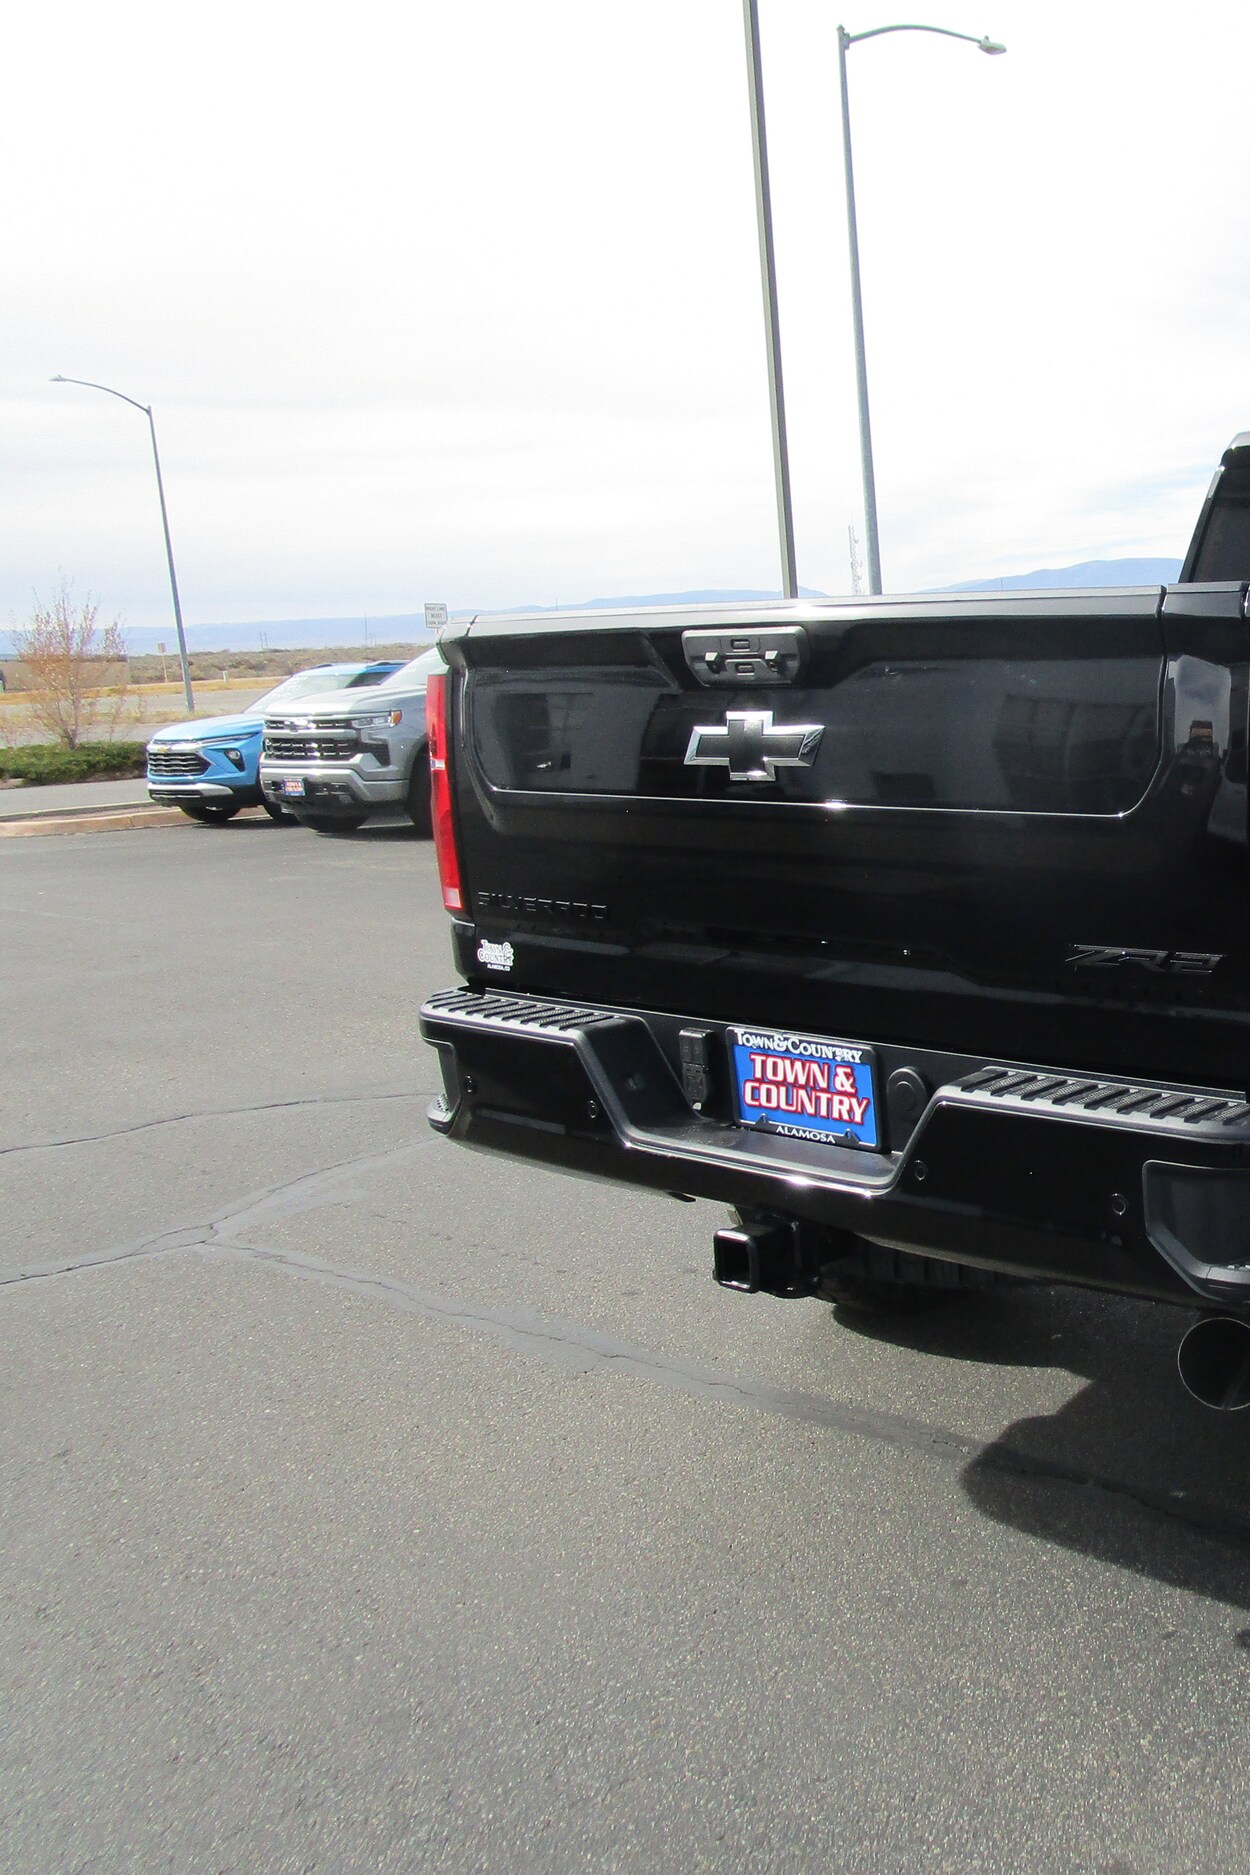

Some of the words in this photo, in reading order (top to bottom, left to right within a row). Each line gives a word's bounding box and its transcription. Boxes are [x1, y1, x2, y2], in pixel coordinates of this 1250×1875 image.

[750, 1052, 830, 1090] TOWN
[834, 1065, 857, 1095] &
[744, 1080, 869, 1125] COUNTRY
[776, 1125, 836, 1144] ALAMOSA
